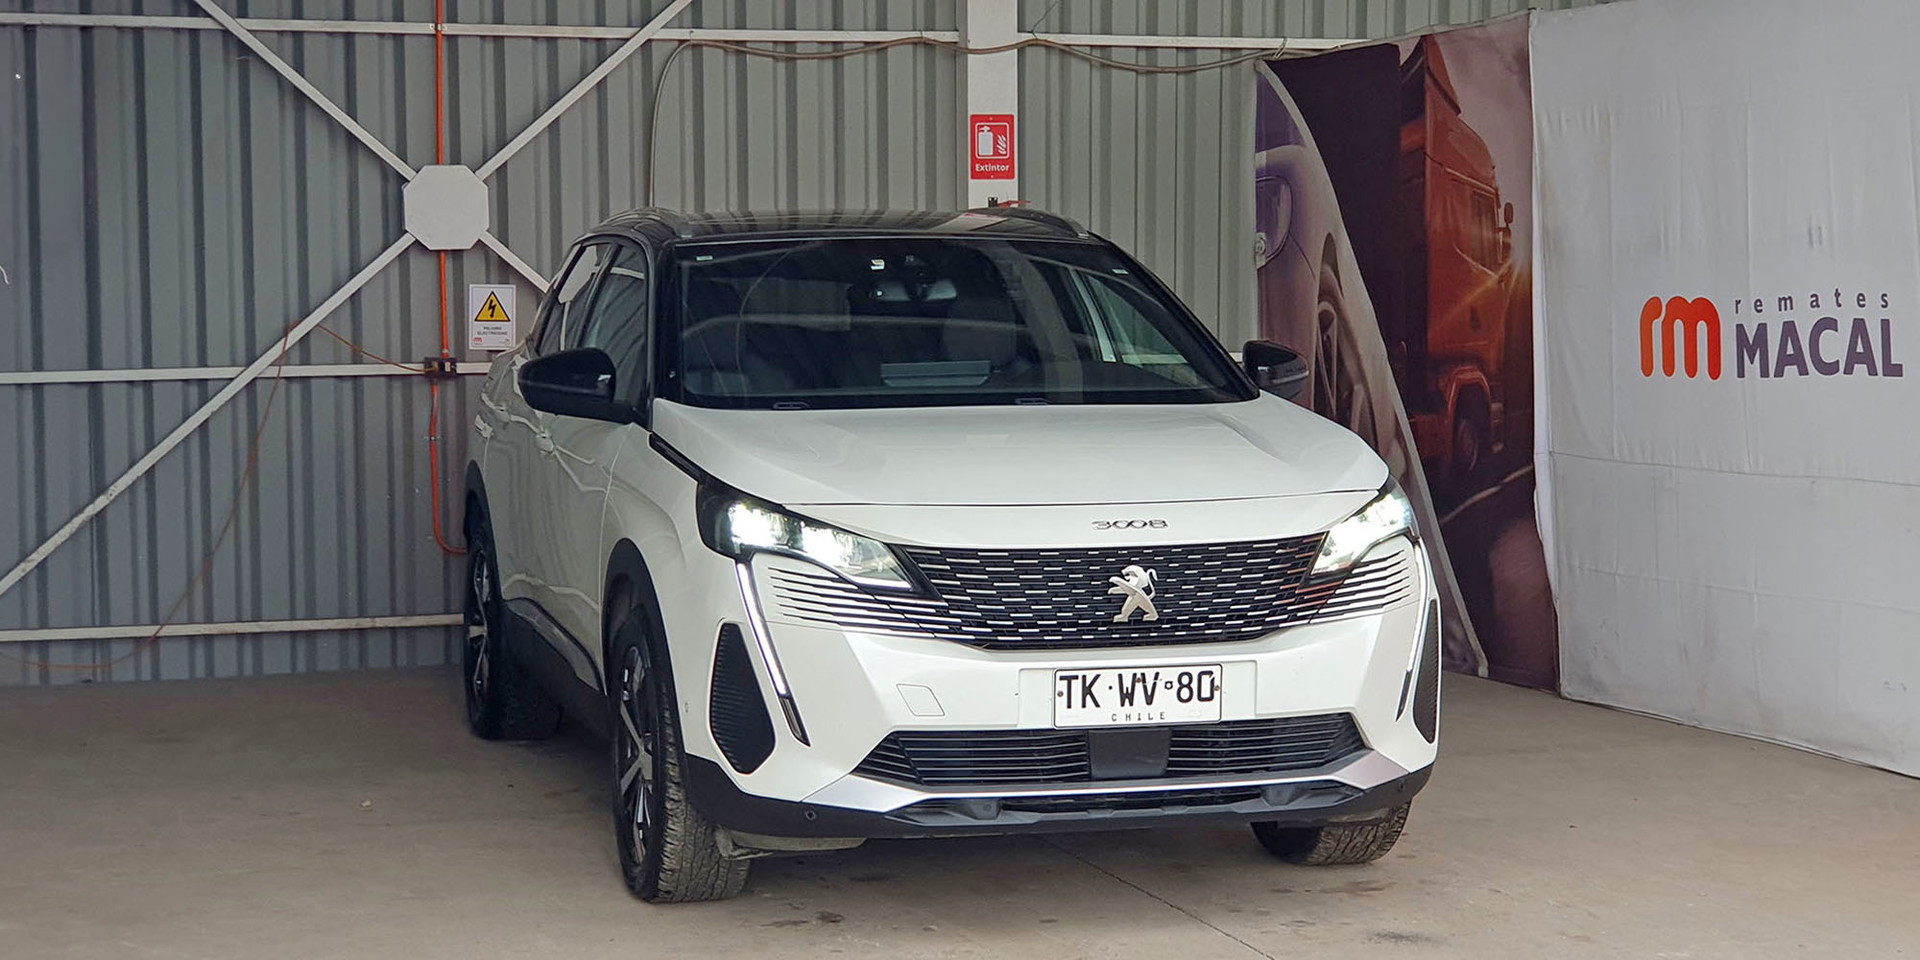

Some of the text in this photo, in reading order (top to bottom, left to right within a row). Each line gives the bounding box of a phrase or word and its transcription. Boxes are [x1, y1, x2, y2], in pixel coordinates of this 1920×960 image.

[975, 163, 1010, 172] Extintor
[1735, 288, 1889, 314] remates
[1736, 317, 1904, 379] MACAL
[1091, 519, 1168, 530] 3008
[1111, 711, 1165, 722] CHILE
